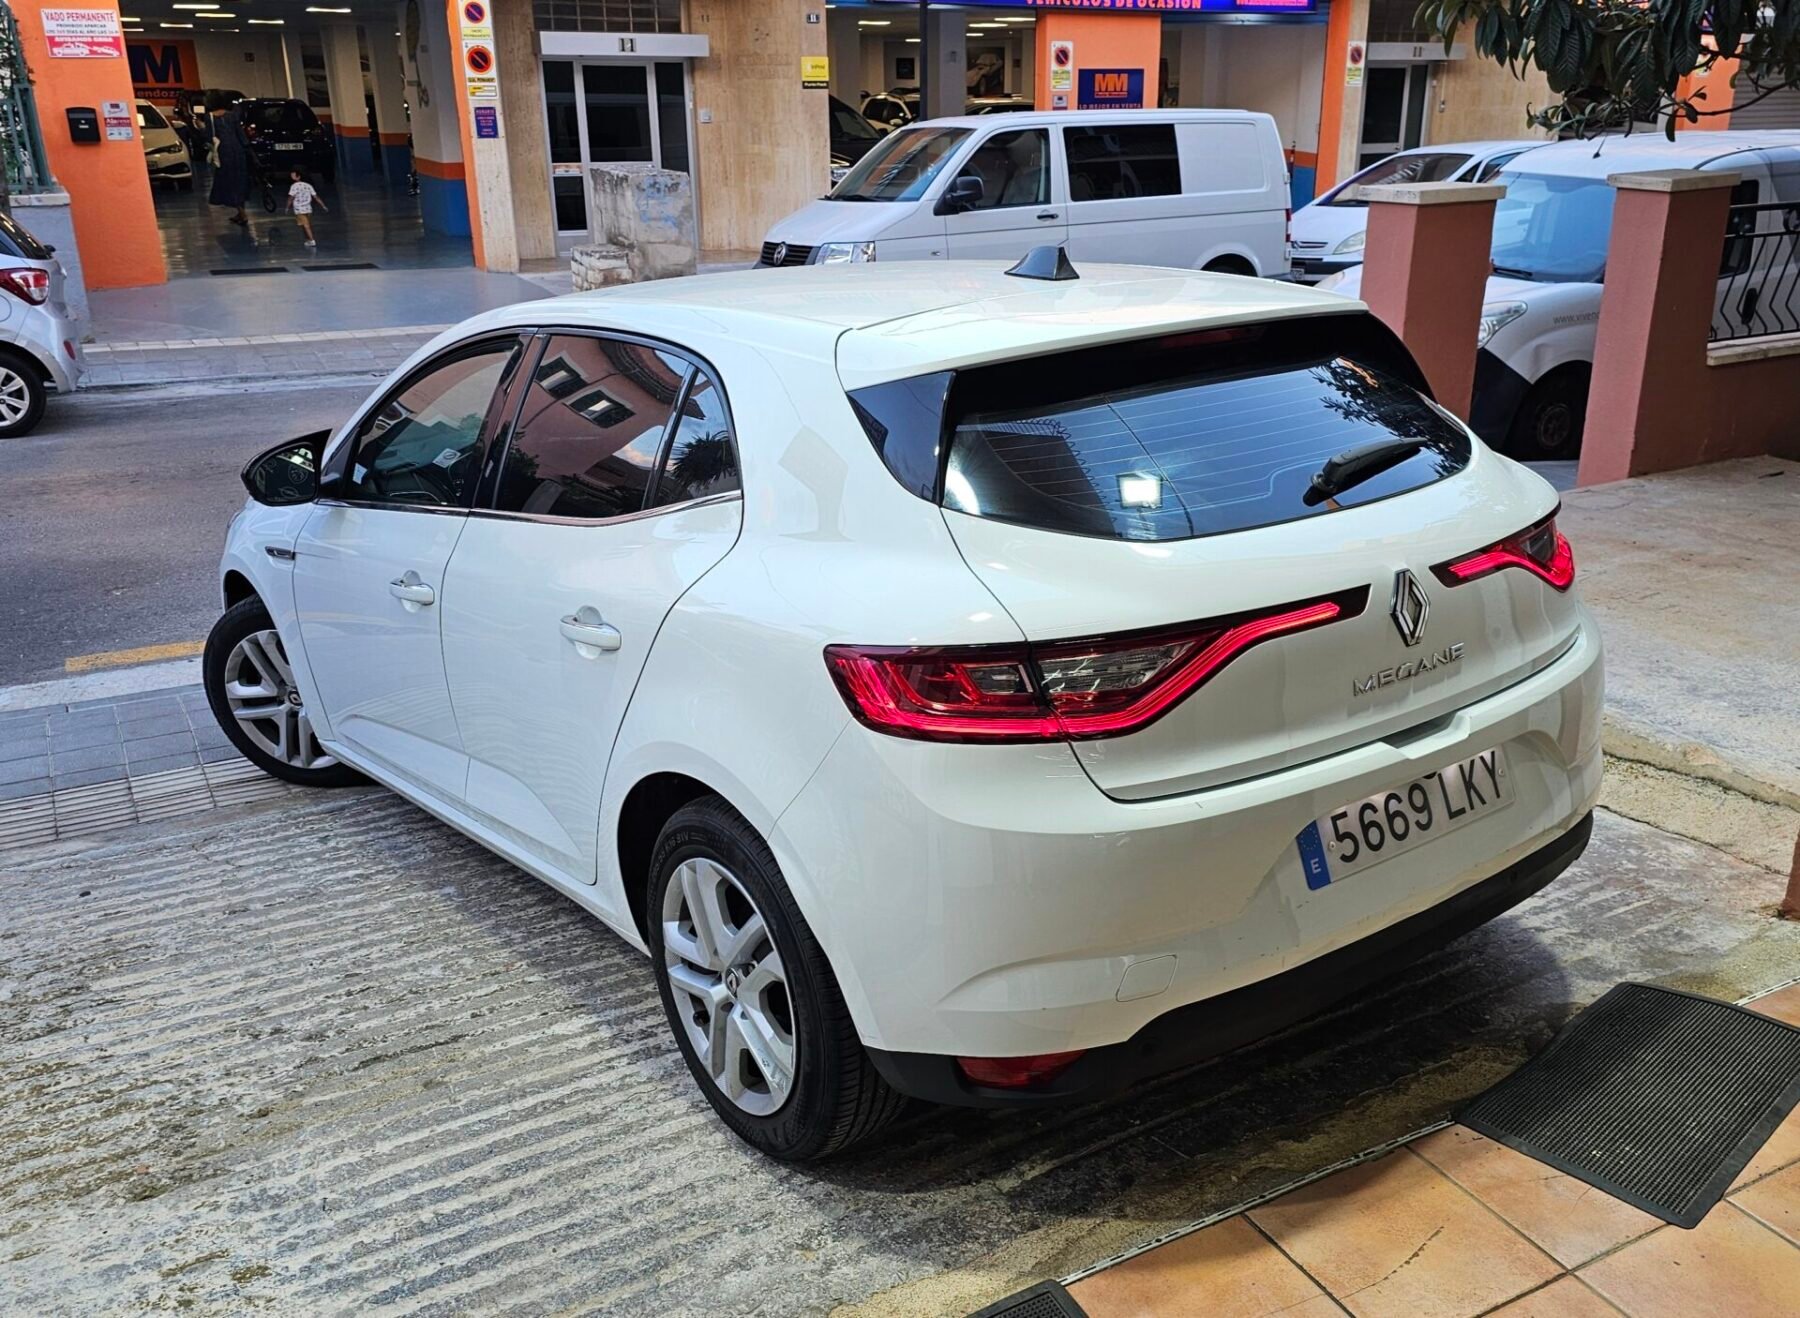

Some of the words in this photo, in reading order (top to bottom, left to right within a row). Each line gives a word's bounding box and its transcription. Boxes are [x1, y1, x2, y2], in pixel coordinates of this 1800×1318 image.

[44, 11, 65, 21] VADO
[66, 12, 115, 22] PERMANENTE
[1352, 642, 1465, 697] MEGANE
[1309, 858, 1321, 874] E
[1331, 782, 1433, 863] 5669
[1437, 750, 1501, 820] LKY
